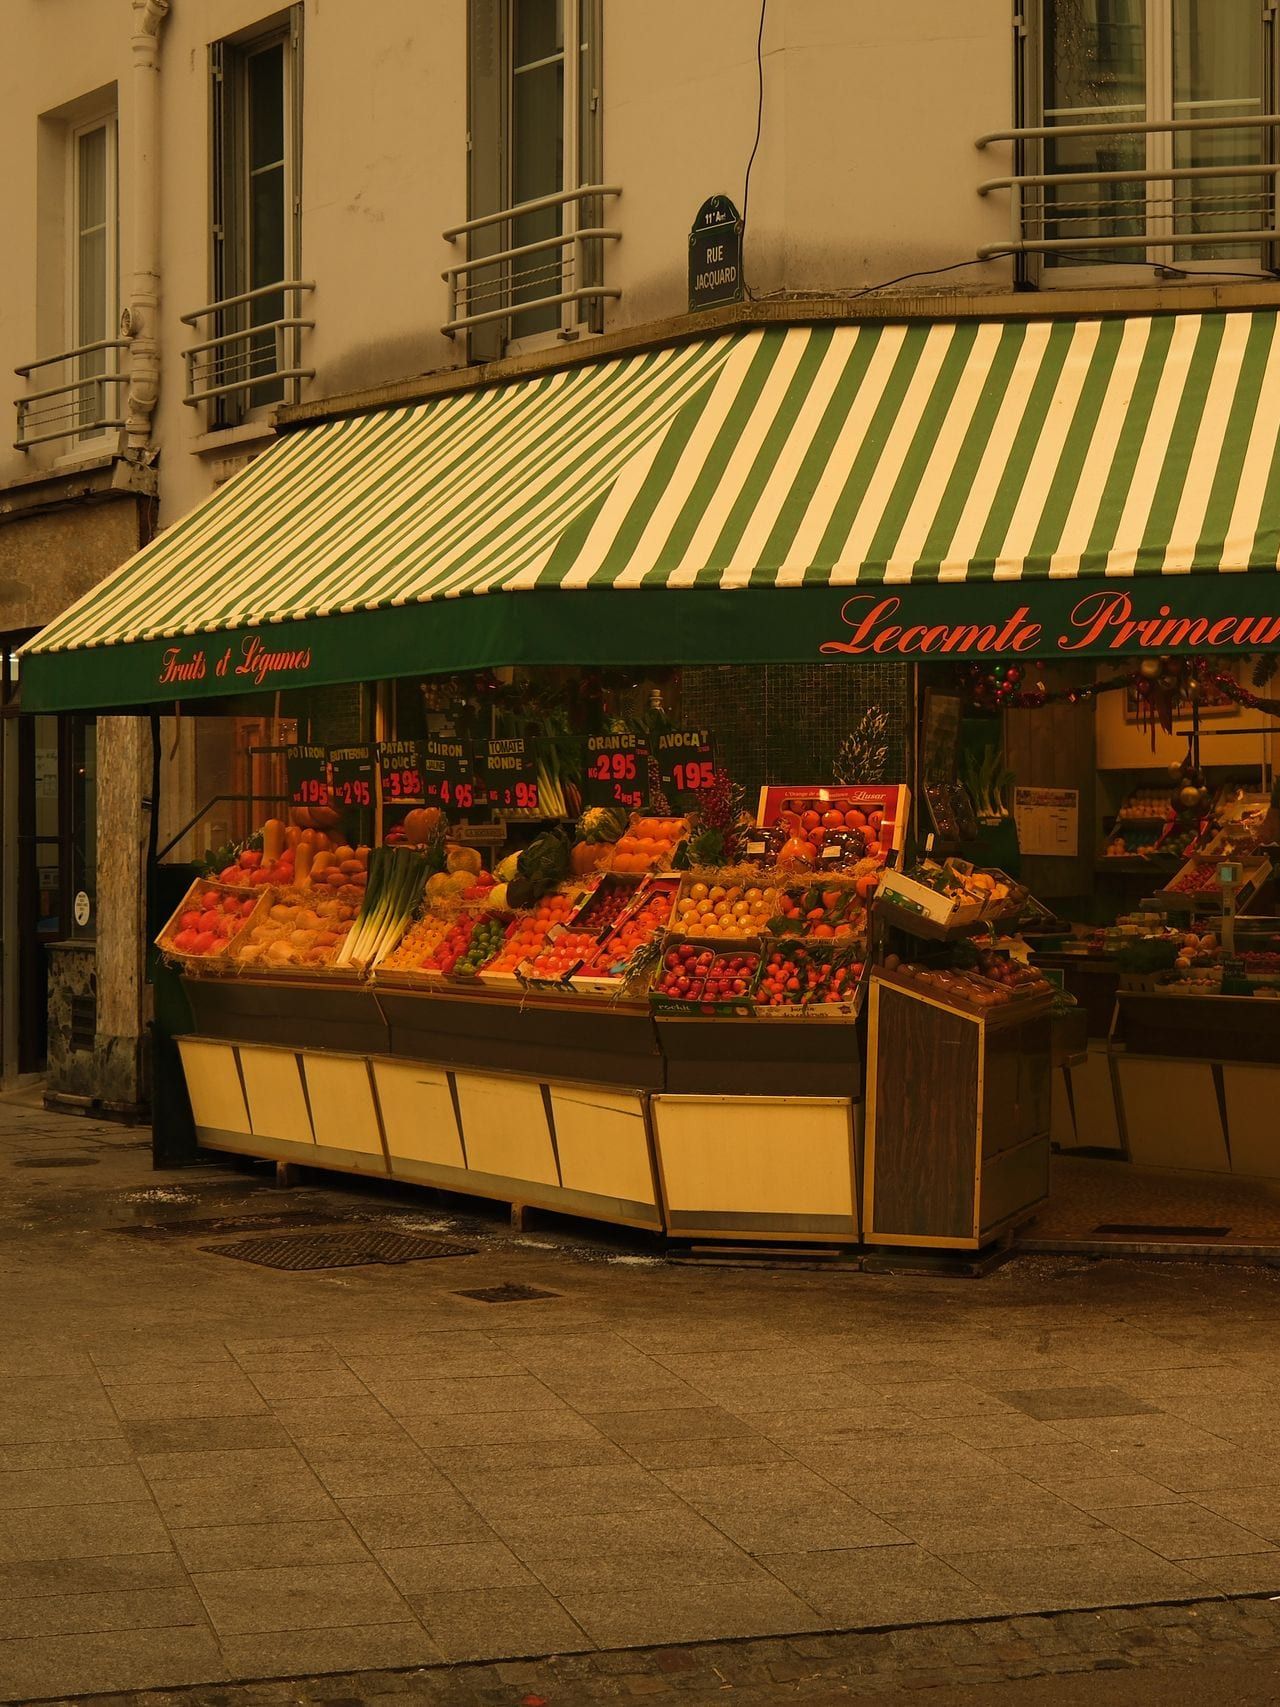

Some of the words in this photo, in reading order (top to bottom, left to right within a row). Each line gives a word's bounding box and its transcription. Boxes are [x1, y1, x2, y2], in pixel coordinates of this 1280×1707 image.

[706, 245, 724, 264] RUE
[695, 266, 737, 291] JACQUARD
[819, 595, 1043, 655] Lecomte
[159, 647, 206, 684] Fruits
[215, 648, 232, 677] et
[235, 636, 312, 685] Légumes
[380, 741, 415, 754] PATATE
[489, 740, 523, 754] TOMATE
[588, 735, 636, 751] ORANGE
[659, 730, 709, 750] AVOCAT
[383, 754, 417, 769] DOUCE
[487, 756, 523, 770] RONDE
